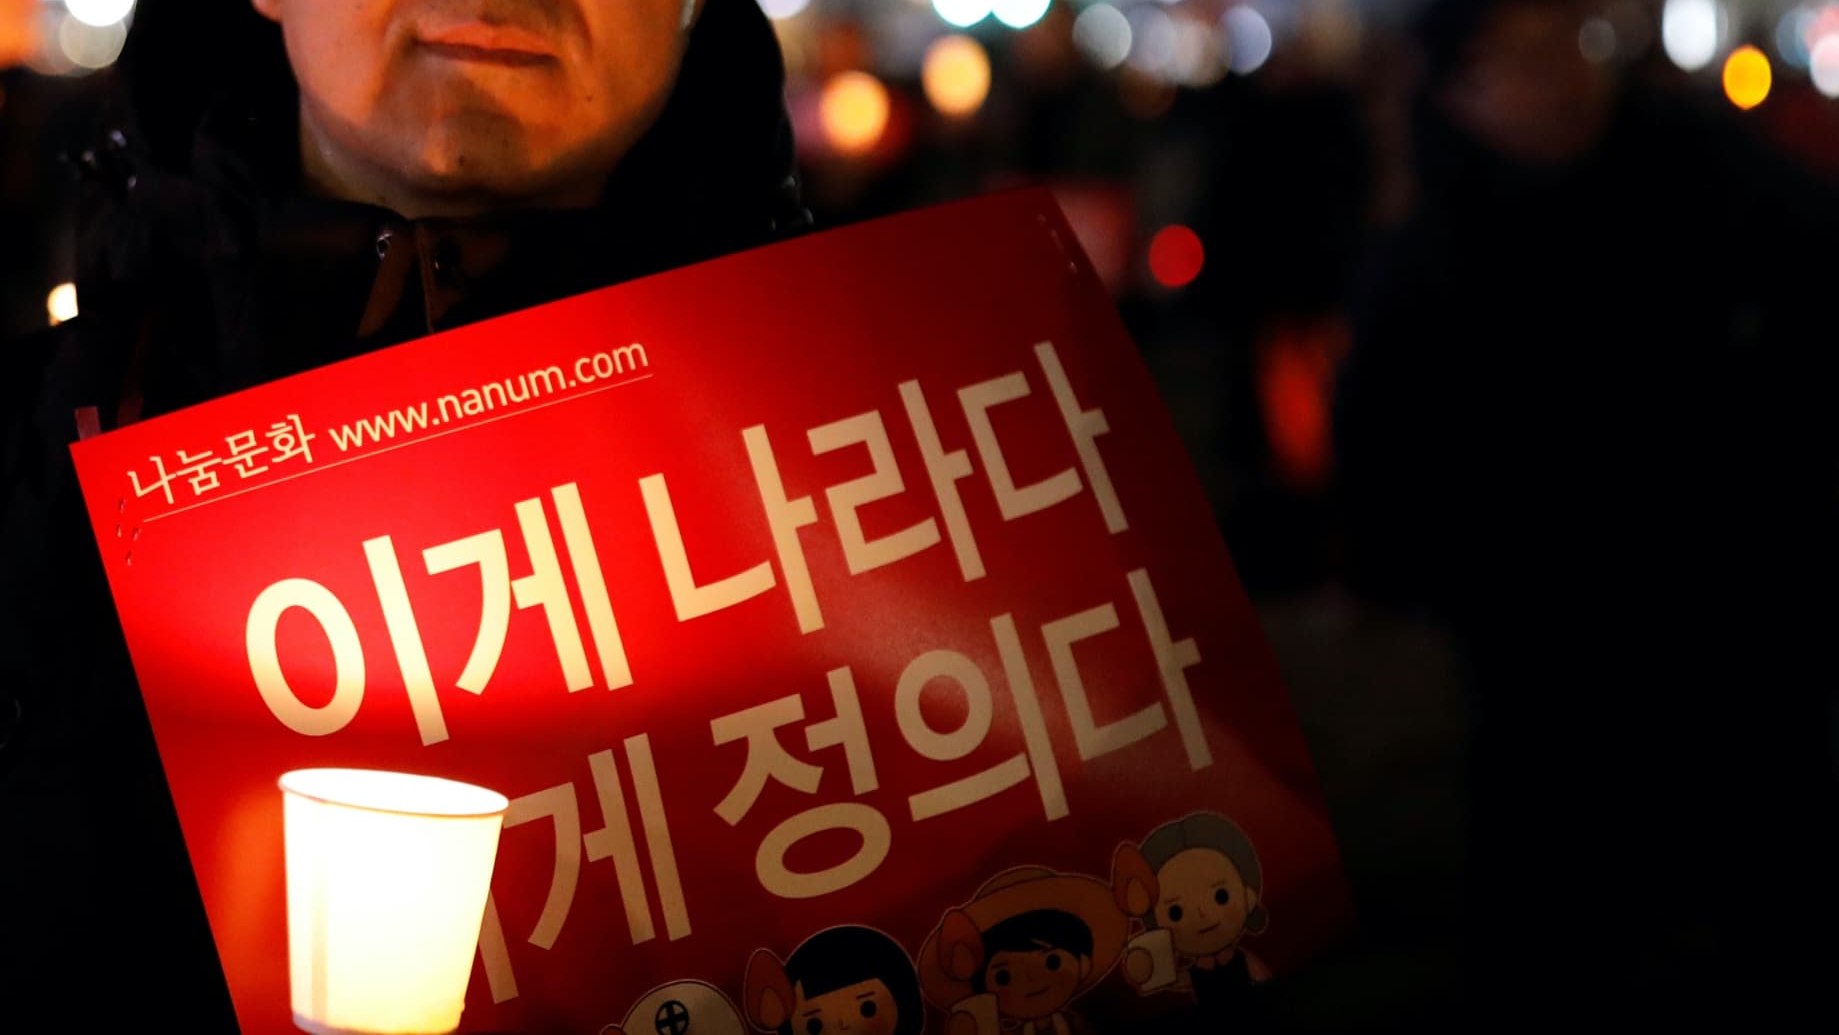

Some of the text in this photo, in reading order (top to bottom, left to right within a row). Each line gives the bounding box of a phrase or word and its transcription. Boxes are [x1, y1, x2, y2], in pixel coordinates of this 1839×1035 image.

[127, 342, 649, 504] 나눔문화 www.nanum.com
[244, 339, 1130, 747] 이게 나라다
[478, 567, 1215, 1005] 게 정의다
